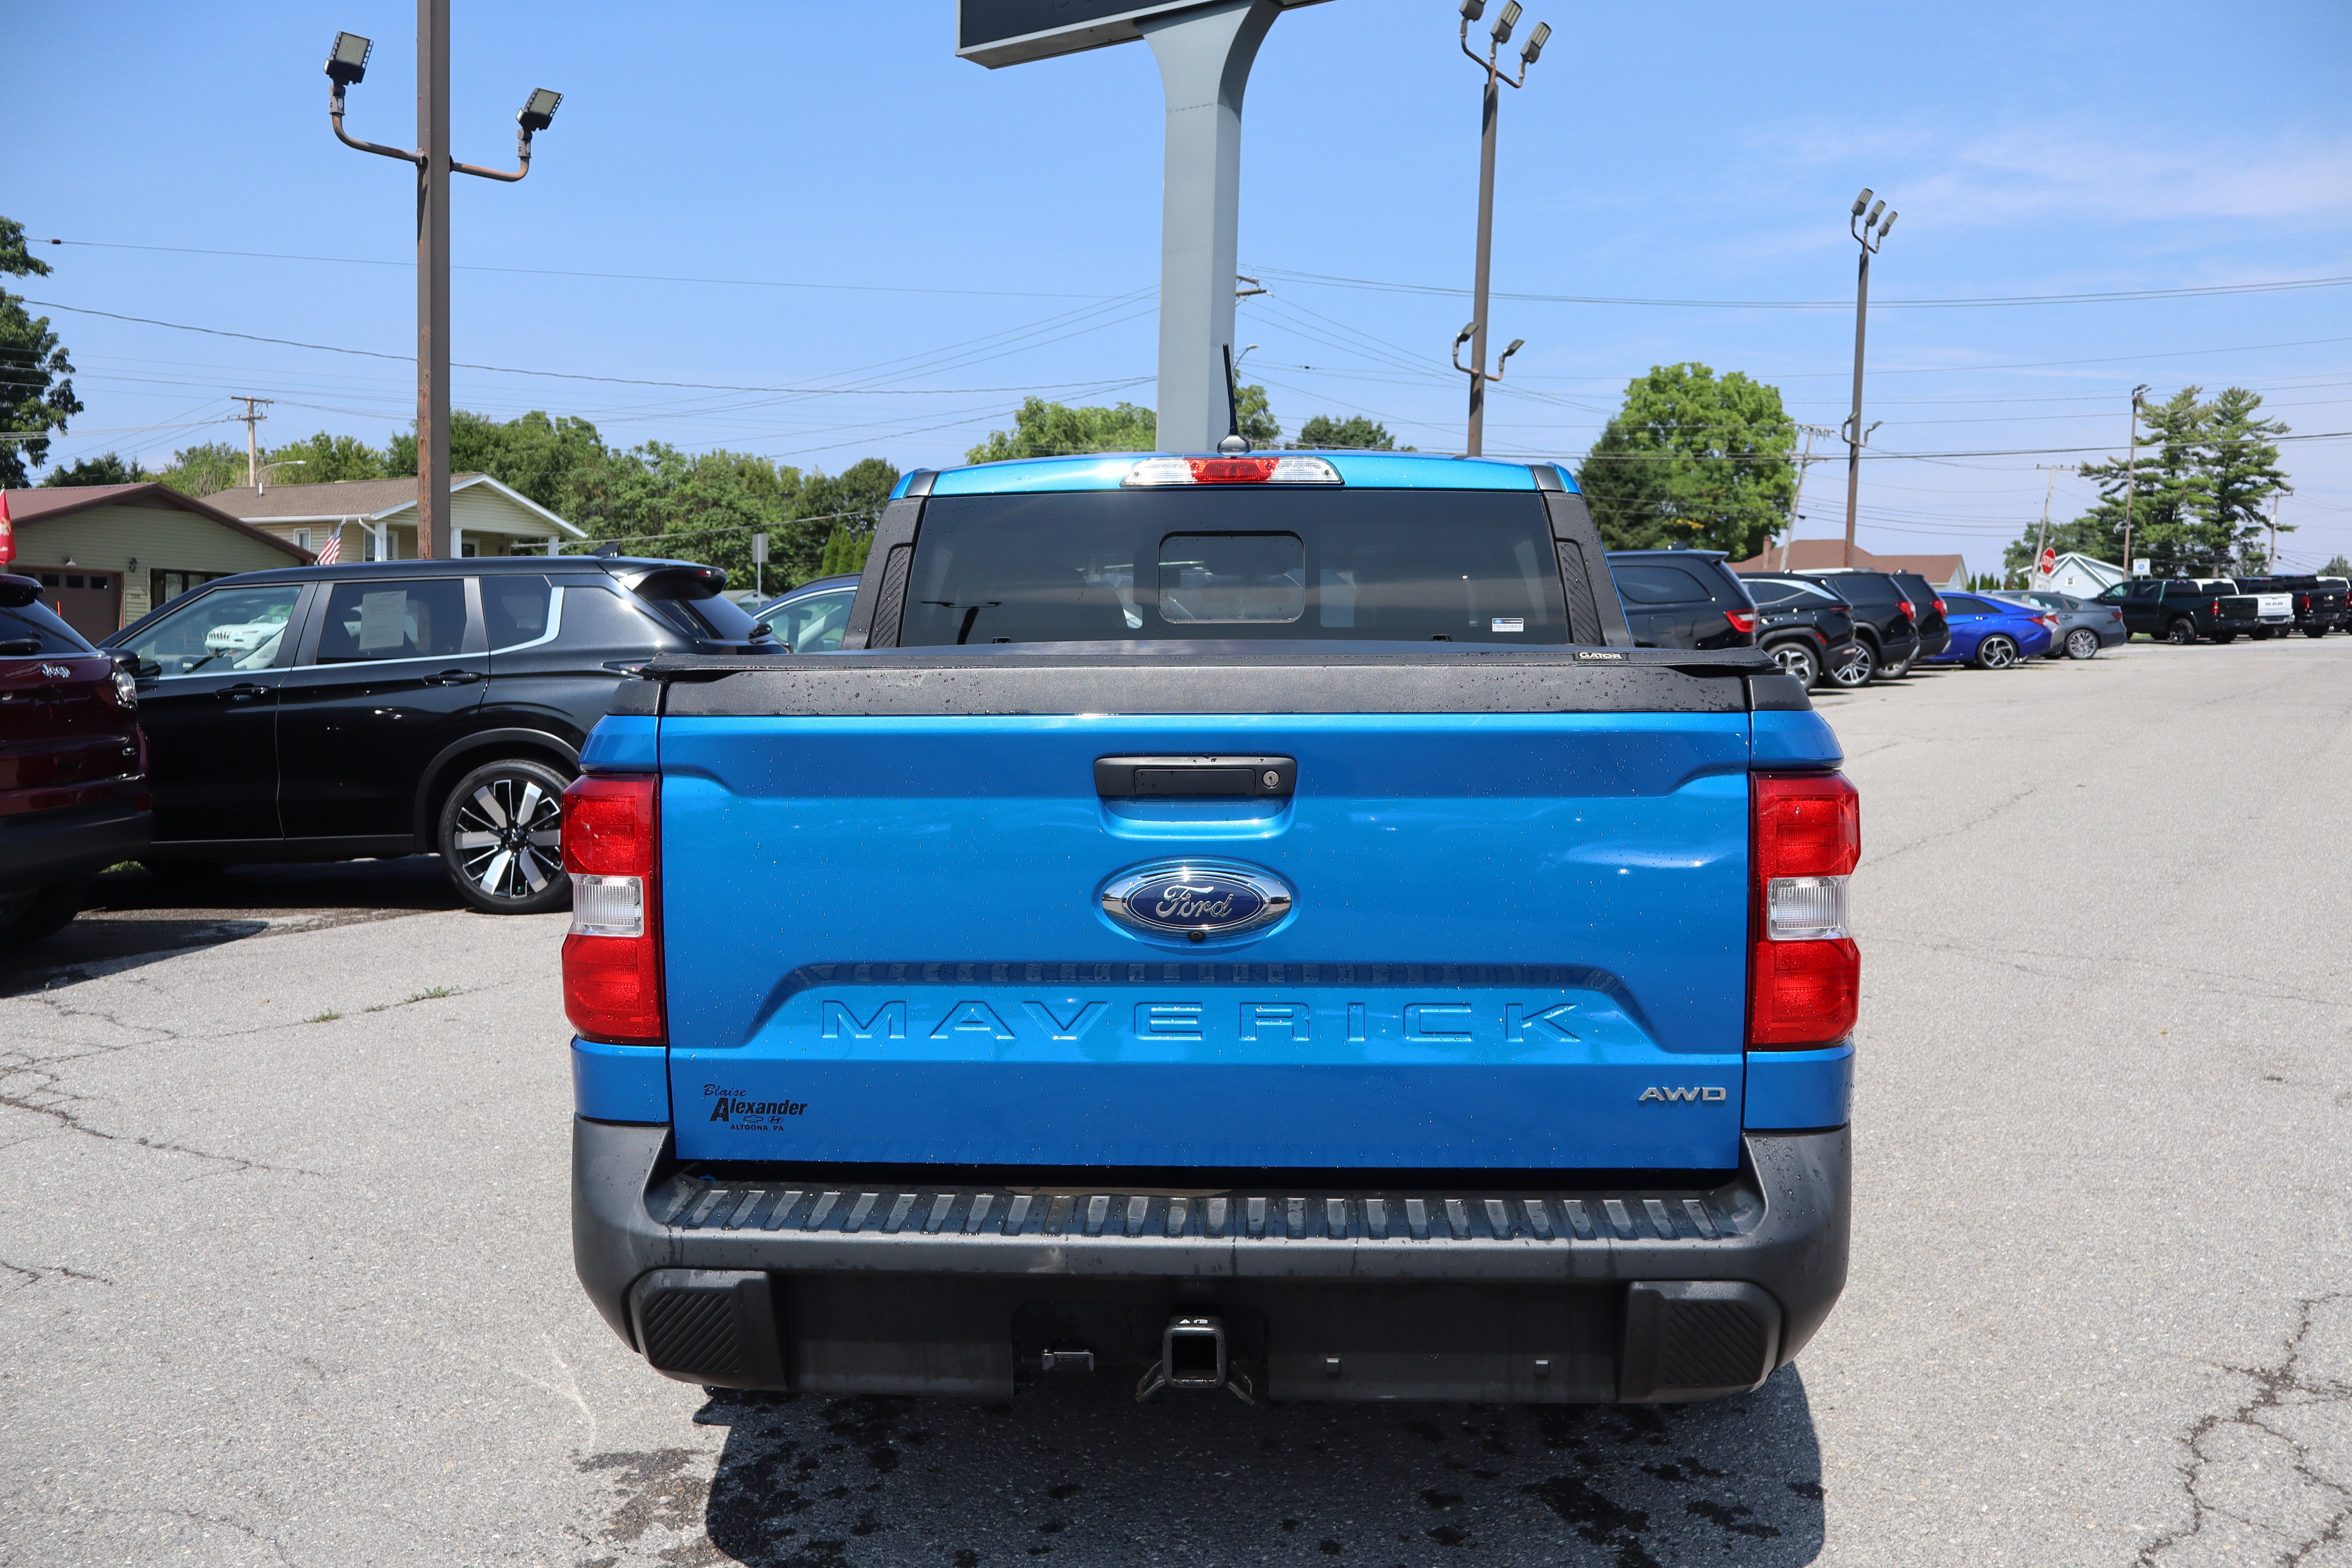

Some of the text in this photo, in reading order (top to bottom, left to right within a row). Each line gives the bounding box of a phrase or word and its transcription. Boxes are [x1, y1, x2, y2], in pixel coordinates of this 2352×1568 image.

[2042, 554, 2055, 568] STOP
[42, 663, 71, 678] Jeep
[1155, 885, 1233, 918] Ford
[822, 1000, 1581, 1042] MAVERICK
[703, 1084, 746, 1097] Blaise
[1637, 1086, 1726, 1101] AWD
[709, 1097, 808, 1122] Alexander
[730, 1124, 771, 1132] ALTOONA,
